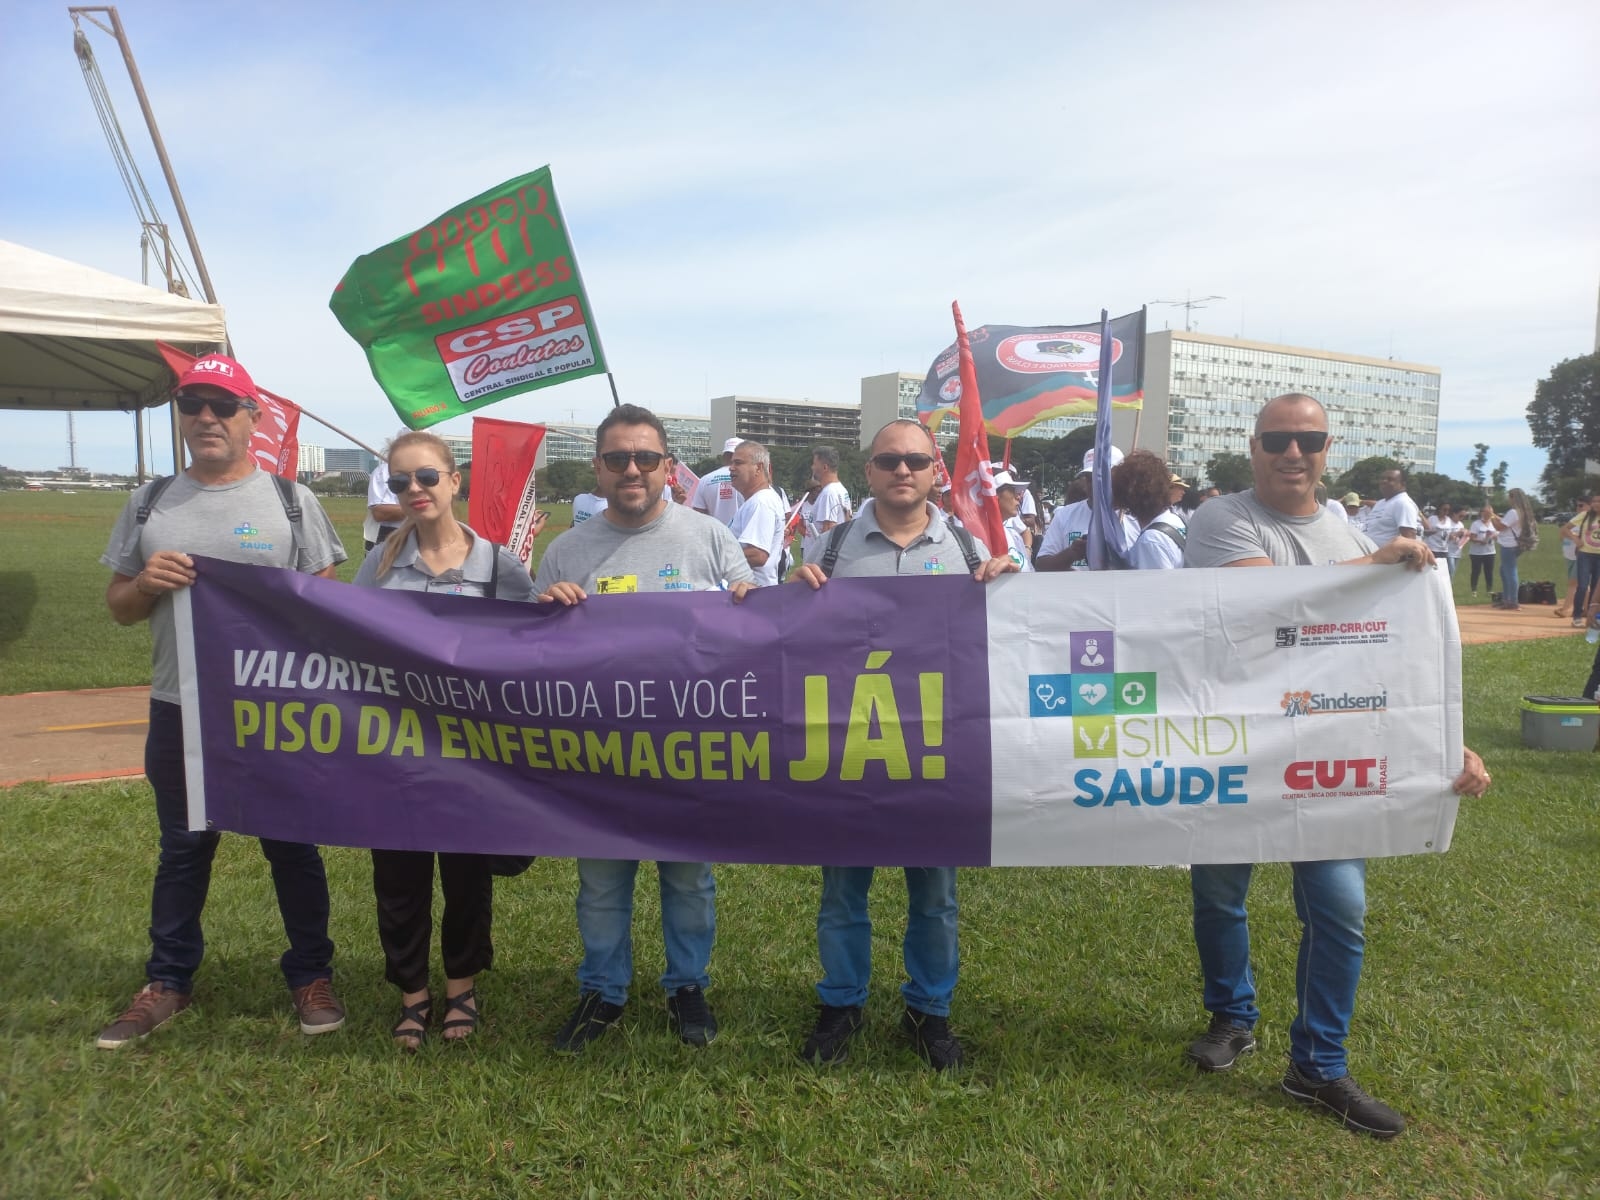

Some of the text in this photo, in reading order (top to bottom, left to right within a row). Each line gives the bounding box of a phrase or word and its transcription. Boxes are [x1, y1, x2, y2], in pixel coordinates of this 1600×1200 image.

[421, 256, 572, 324] SINDEESS
[449, 304, 575, 353] CSP
[194, 359, 230, 373] CUT
[463, 381, 503, 398] CENTRAL
[505, 371, 546, 385] SINDICAL
[554, 358, 592, 373] POPULAR
[464, 335, 584, 386] Conlutas
[1301, 621, 1388, 635] SISERP-CRR/CUT
[234, 649, 767, 719] VALORIZE QUEM CUIDA DE VOCÊ.
[1311, 691, 1388, 711] Sindserpi
[233, 699, 771, 781] PISO DA ENFERMAGEM
[789, 650, 946, 782] JÁ!
[1121, 714, 1248, 758] SINDI
[1072, 760, 1249, 808] SAÚDE
[1284, 758, 1376, 791] CUT
